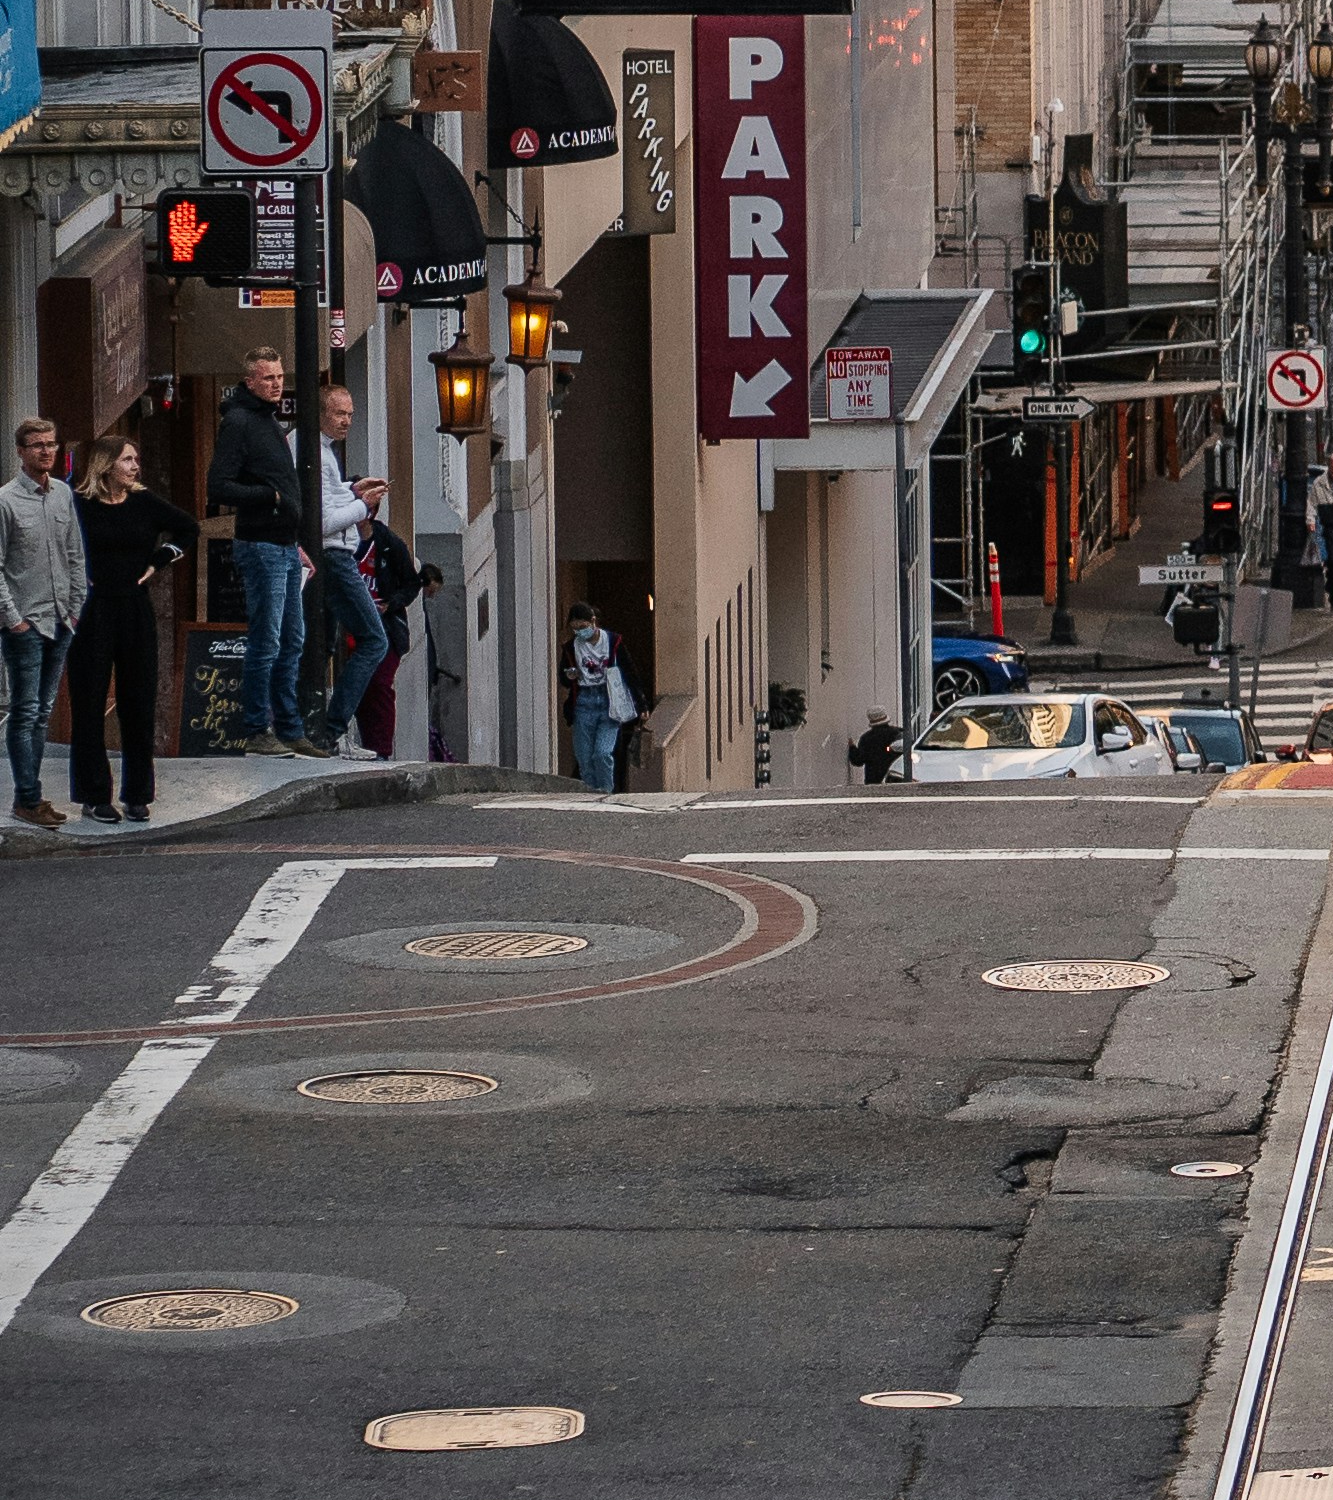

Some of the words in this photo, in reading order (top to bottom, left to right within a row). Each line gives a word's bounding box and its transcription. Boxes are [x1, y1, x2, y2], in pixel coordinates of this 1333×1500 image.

[626, 60, 672, 75] HOTEL
[548, 126, 613, 149] ACADEMY
[629, 83, 673, 212] PARKING
[721, 36, 792, 338] PARK
[266, 205, 295, 215] CABL
[412, 260, 483, 285] ACADEMY
[832, 350, 885, 360] TOW-AWAY
[829, 360, 845, 377] NO
[848, 363, 888, 377] STOPPING
[847, 380, 872, 393] ANY
[845, 394, 874, 407] TIME
[1030, 402, 1051, 414] ONE
[1054, 402, 1076, 414] WAY
[1158, 569, 1207, 580] Sutter
